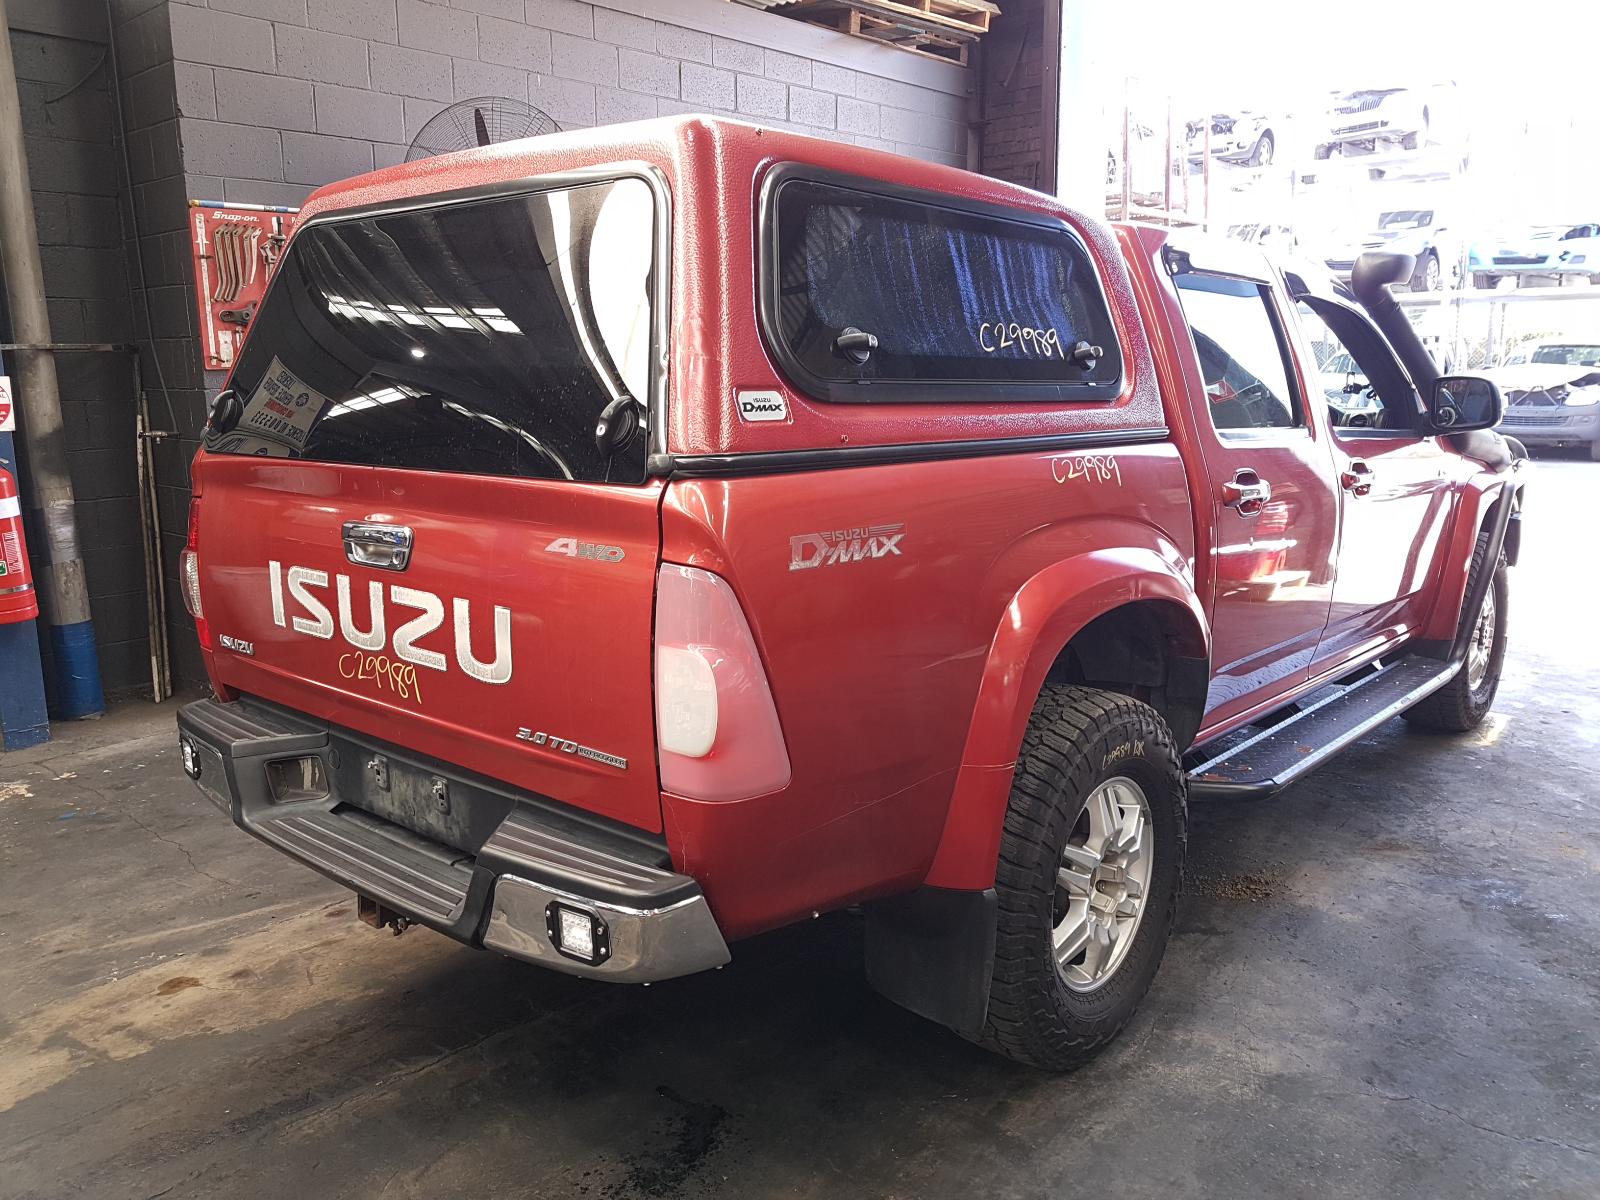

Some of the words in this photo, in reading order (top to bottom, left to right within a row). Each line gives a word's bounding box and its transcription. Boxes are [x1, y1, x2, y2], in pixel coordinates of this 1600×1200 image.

[979, 322, 1065, 359] C29989
[1052, 455, 1121, 486] C29989
[544, 537, 625, 563] 4WD
[832, 527, 869, 542] ISUZU
[268, 560, 512, 684] ISUZU
[219, 633, 254, 656] ISUZU
[339, 651, 422, 704] C29989
